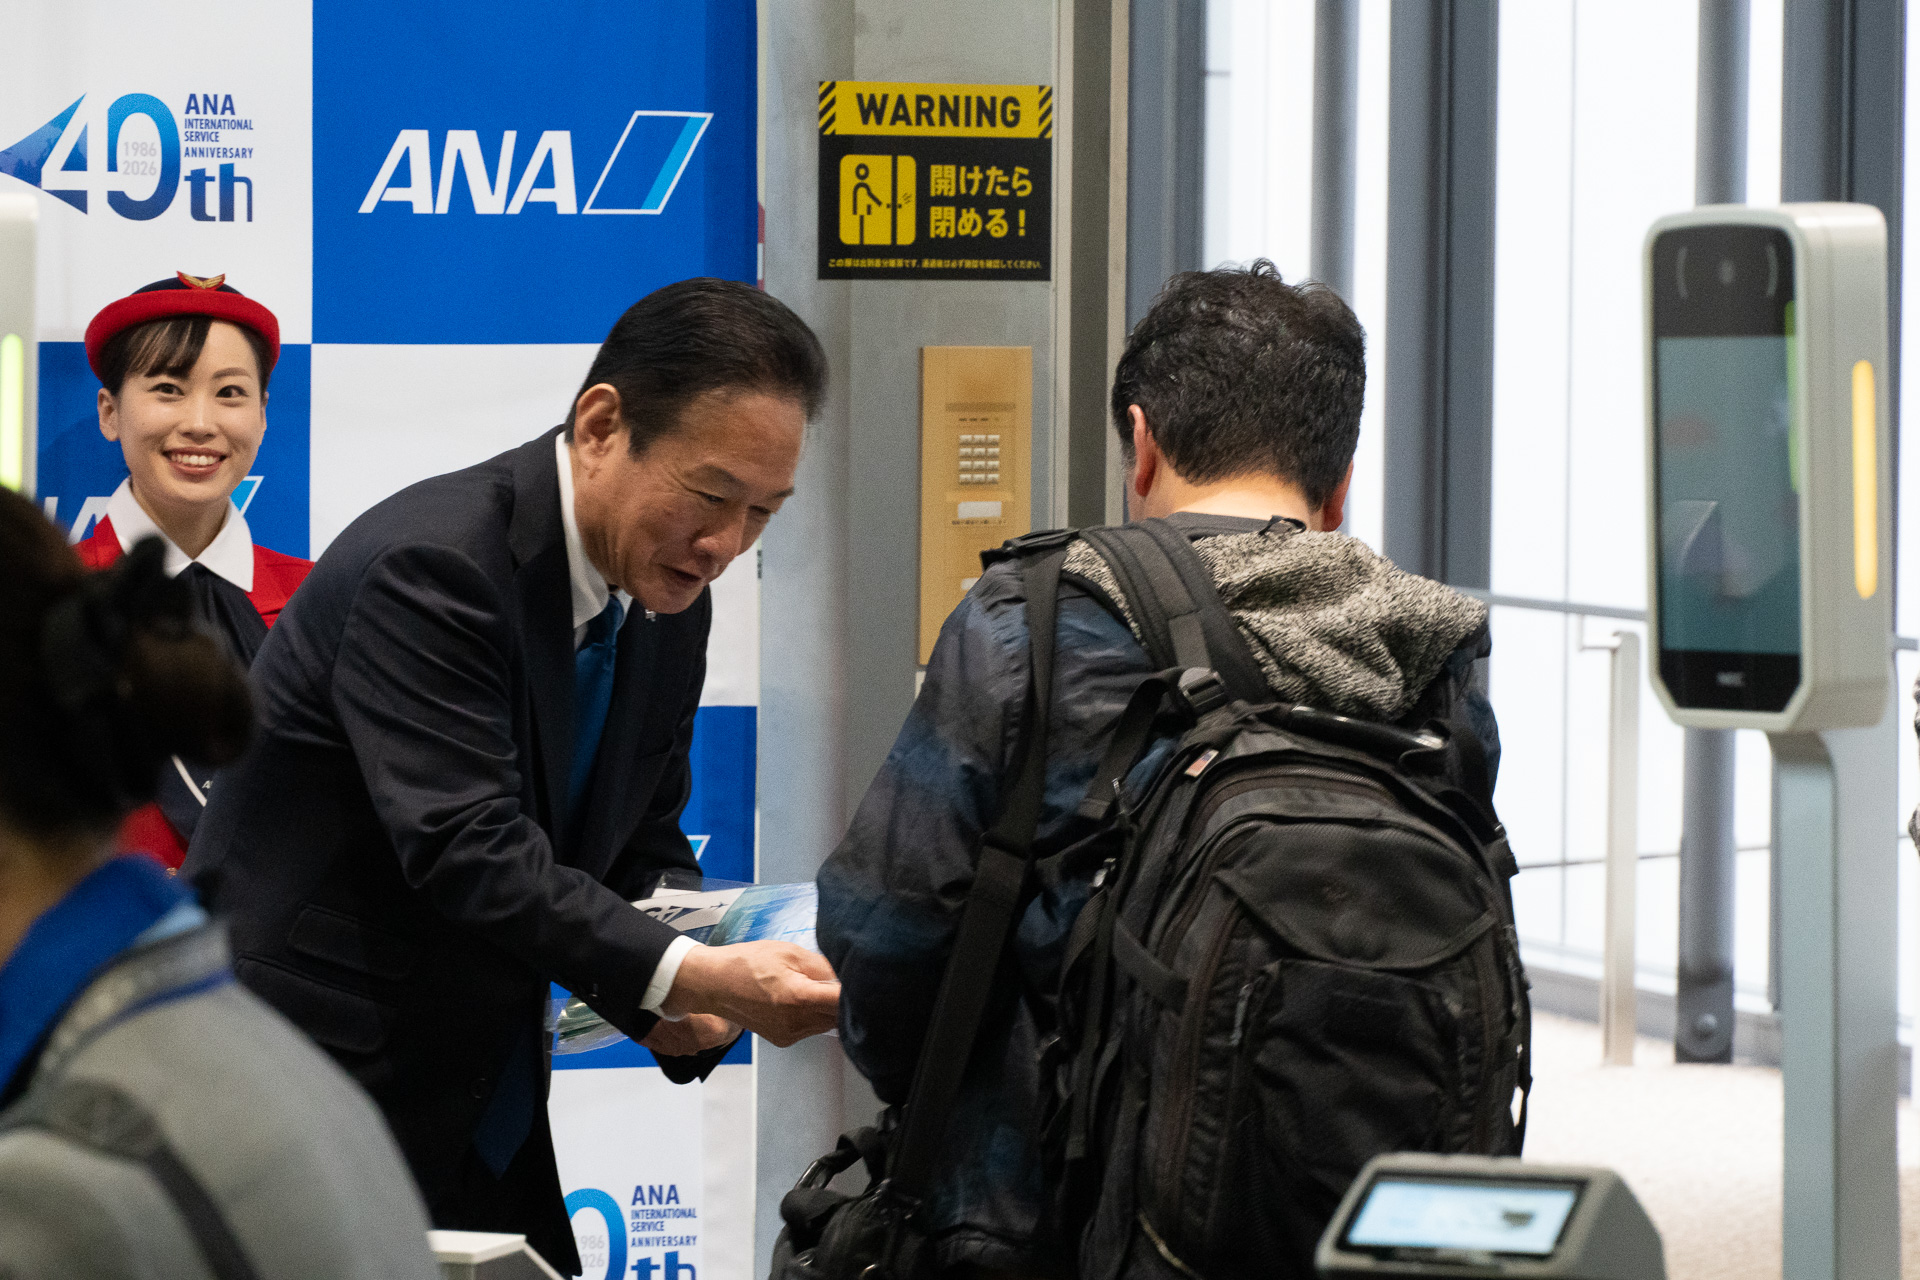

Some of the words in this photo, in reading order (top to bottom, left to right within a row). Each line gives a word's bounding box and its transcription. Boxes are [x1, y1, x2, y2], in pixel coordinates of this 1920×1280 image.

[184, 93, 236, 116] ANA
[855, 92, 1021, 129] WARNING
[184, 118, 254, 131] INTERNATIONAL
[184, 131, 220, 143] SERVICE
[123, 141, 157, 157] 1986
[184, 146, 254, 159] ANNIVERSARY
[122, 160, 157, 176] 2026
[357, 129, 578, 215] ANA
[929, 164, 1033, 198] 開けたら
[929, 205, 1027, 239] 閉める！
[631, 1184, 681, 1206] ANA
[630, 1208, 697, 1220] INTERNATIONAL
[630, 1220, 665, 1233] SERVICE
[579, 1234, 605, 1250] 986
[630, 1235, 697, 1248] ANNIVERSARY
